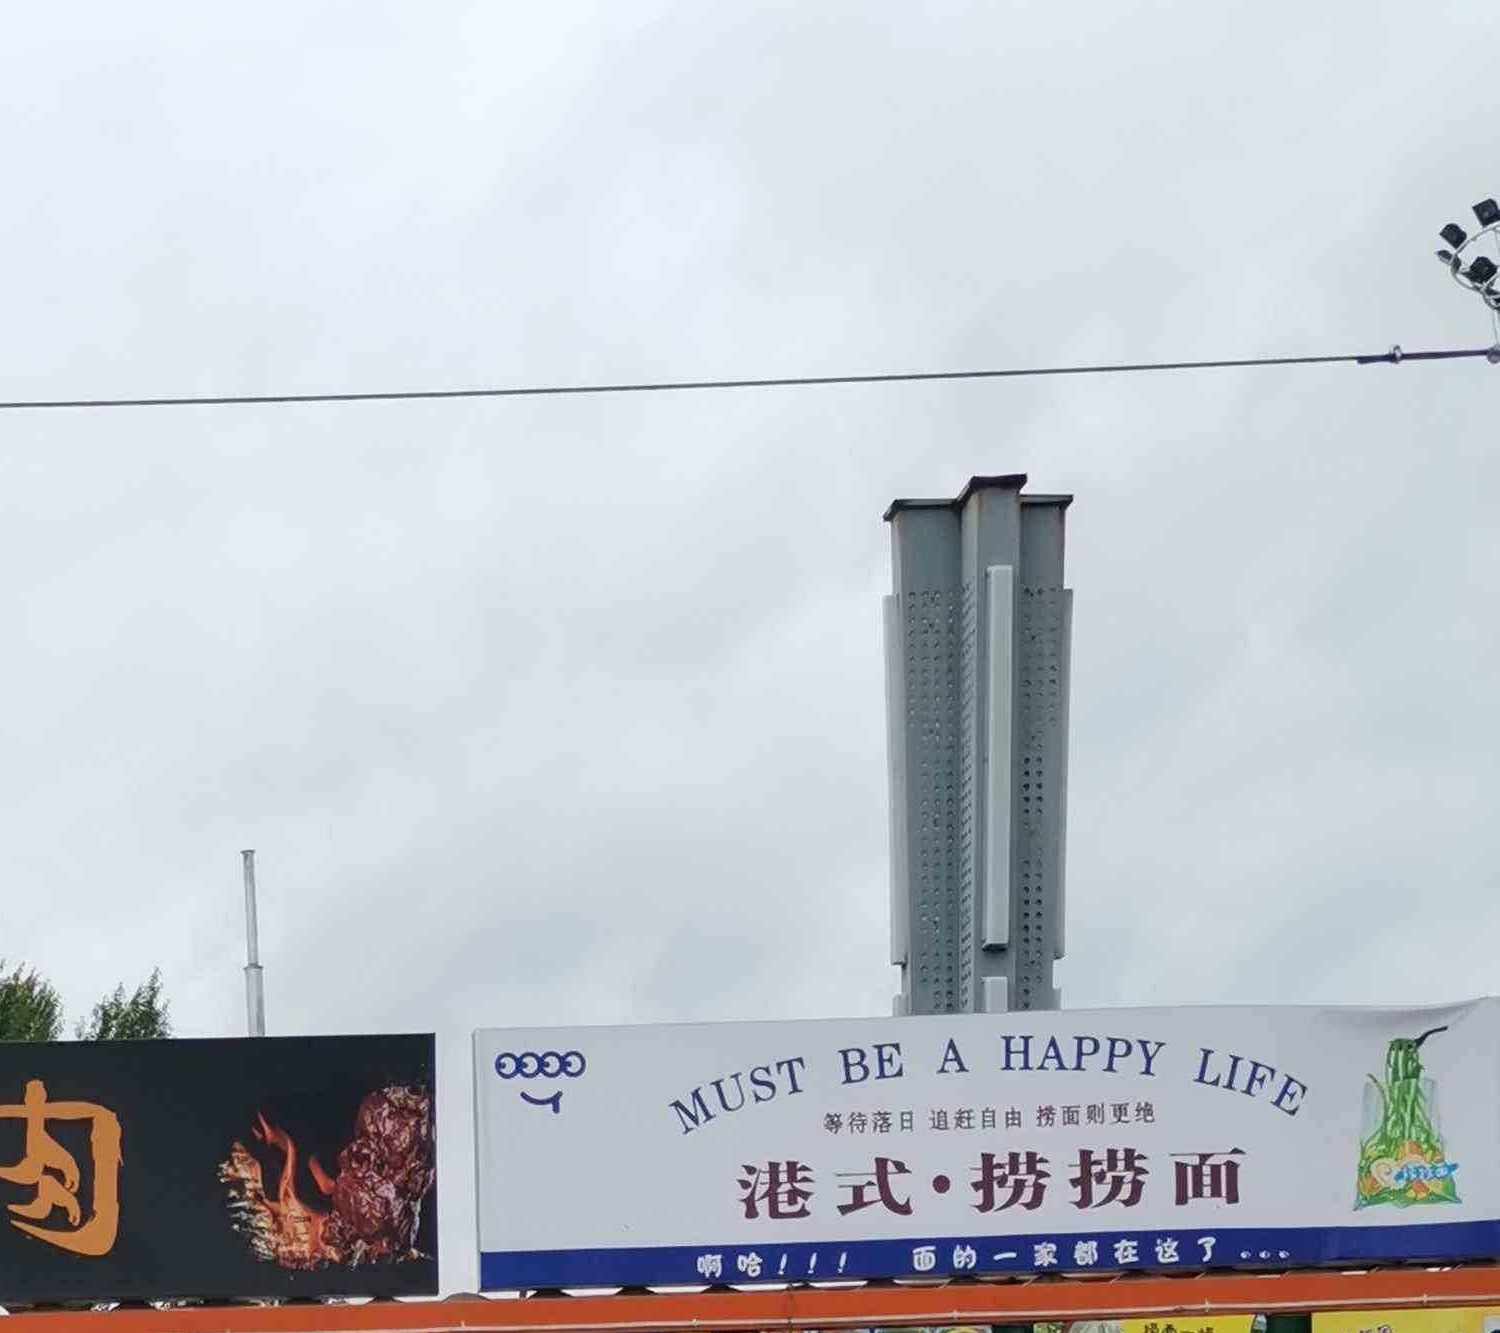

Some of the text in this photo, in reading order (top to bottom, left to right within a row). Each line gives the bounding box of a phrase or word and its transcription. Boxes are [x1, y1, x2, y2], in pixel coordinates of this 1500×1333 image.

[669, 1034, 1309, 1135] MUST BE A HAPPY LIFE
[822, 1109, 914, 1135] 等待落日
[928, 1106, 1022, 1131] 追赶自由
